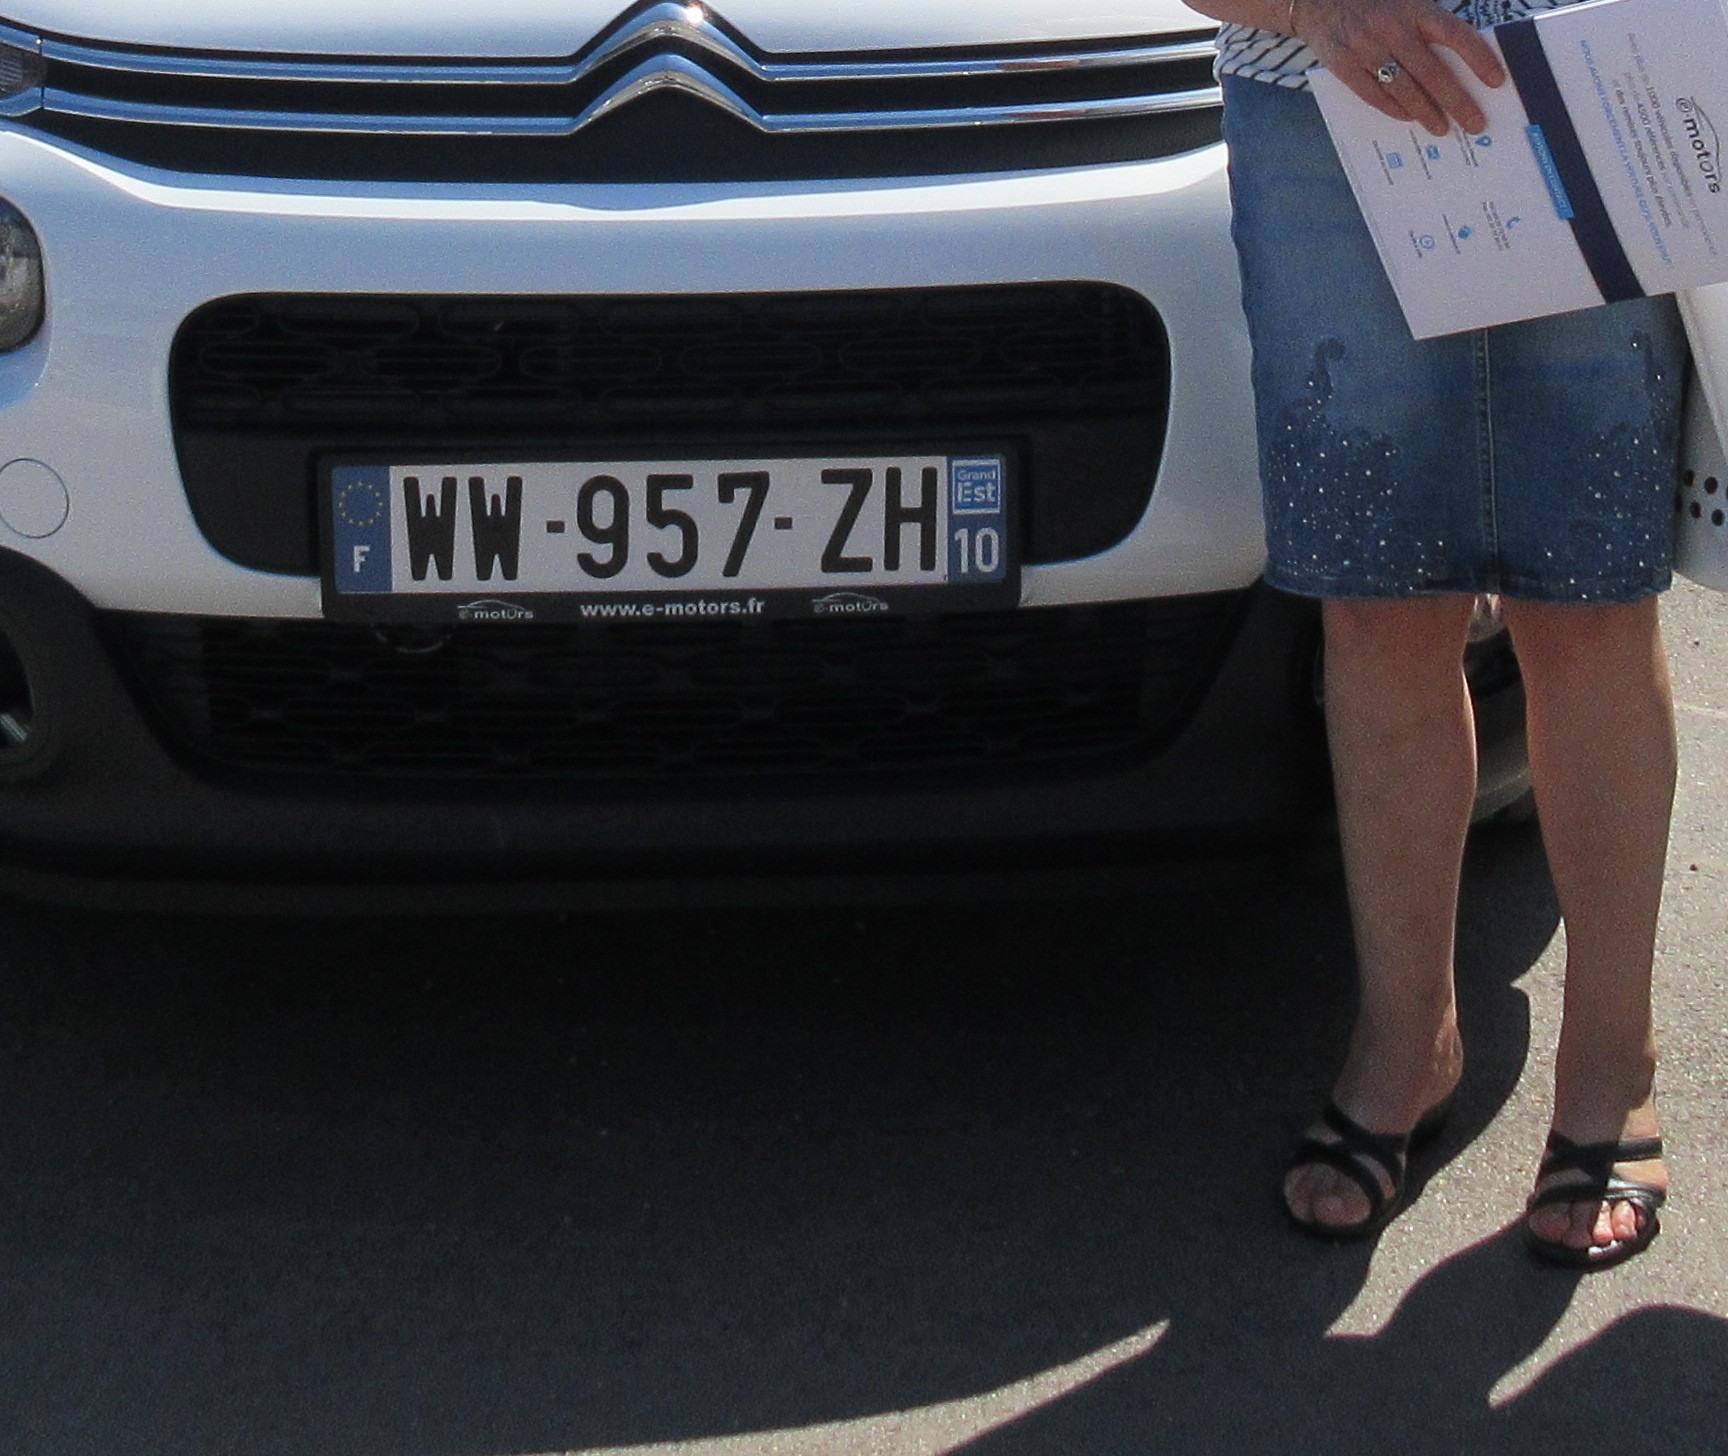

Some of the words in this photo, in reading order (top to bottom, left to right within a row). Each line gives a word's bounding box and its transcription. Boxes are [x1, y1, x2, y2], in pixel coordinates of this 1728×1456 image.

[956, 468, 996, 482] Grand
[957, 482, 996, 503] Est
[353, 545, 370, 573] F
[954, 527, 1000, 574] 10
[580, 597, 766, 618] www.e-motors.fr
